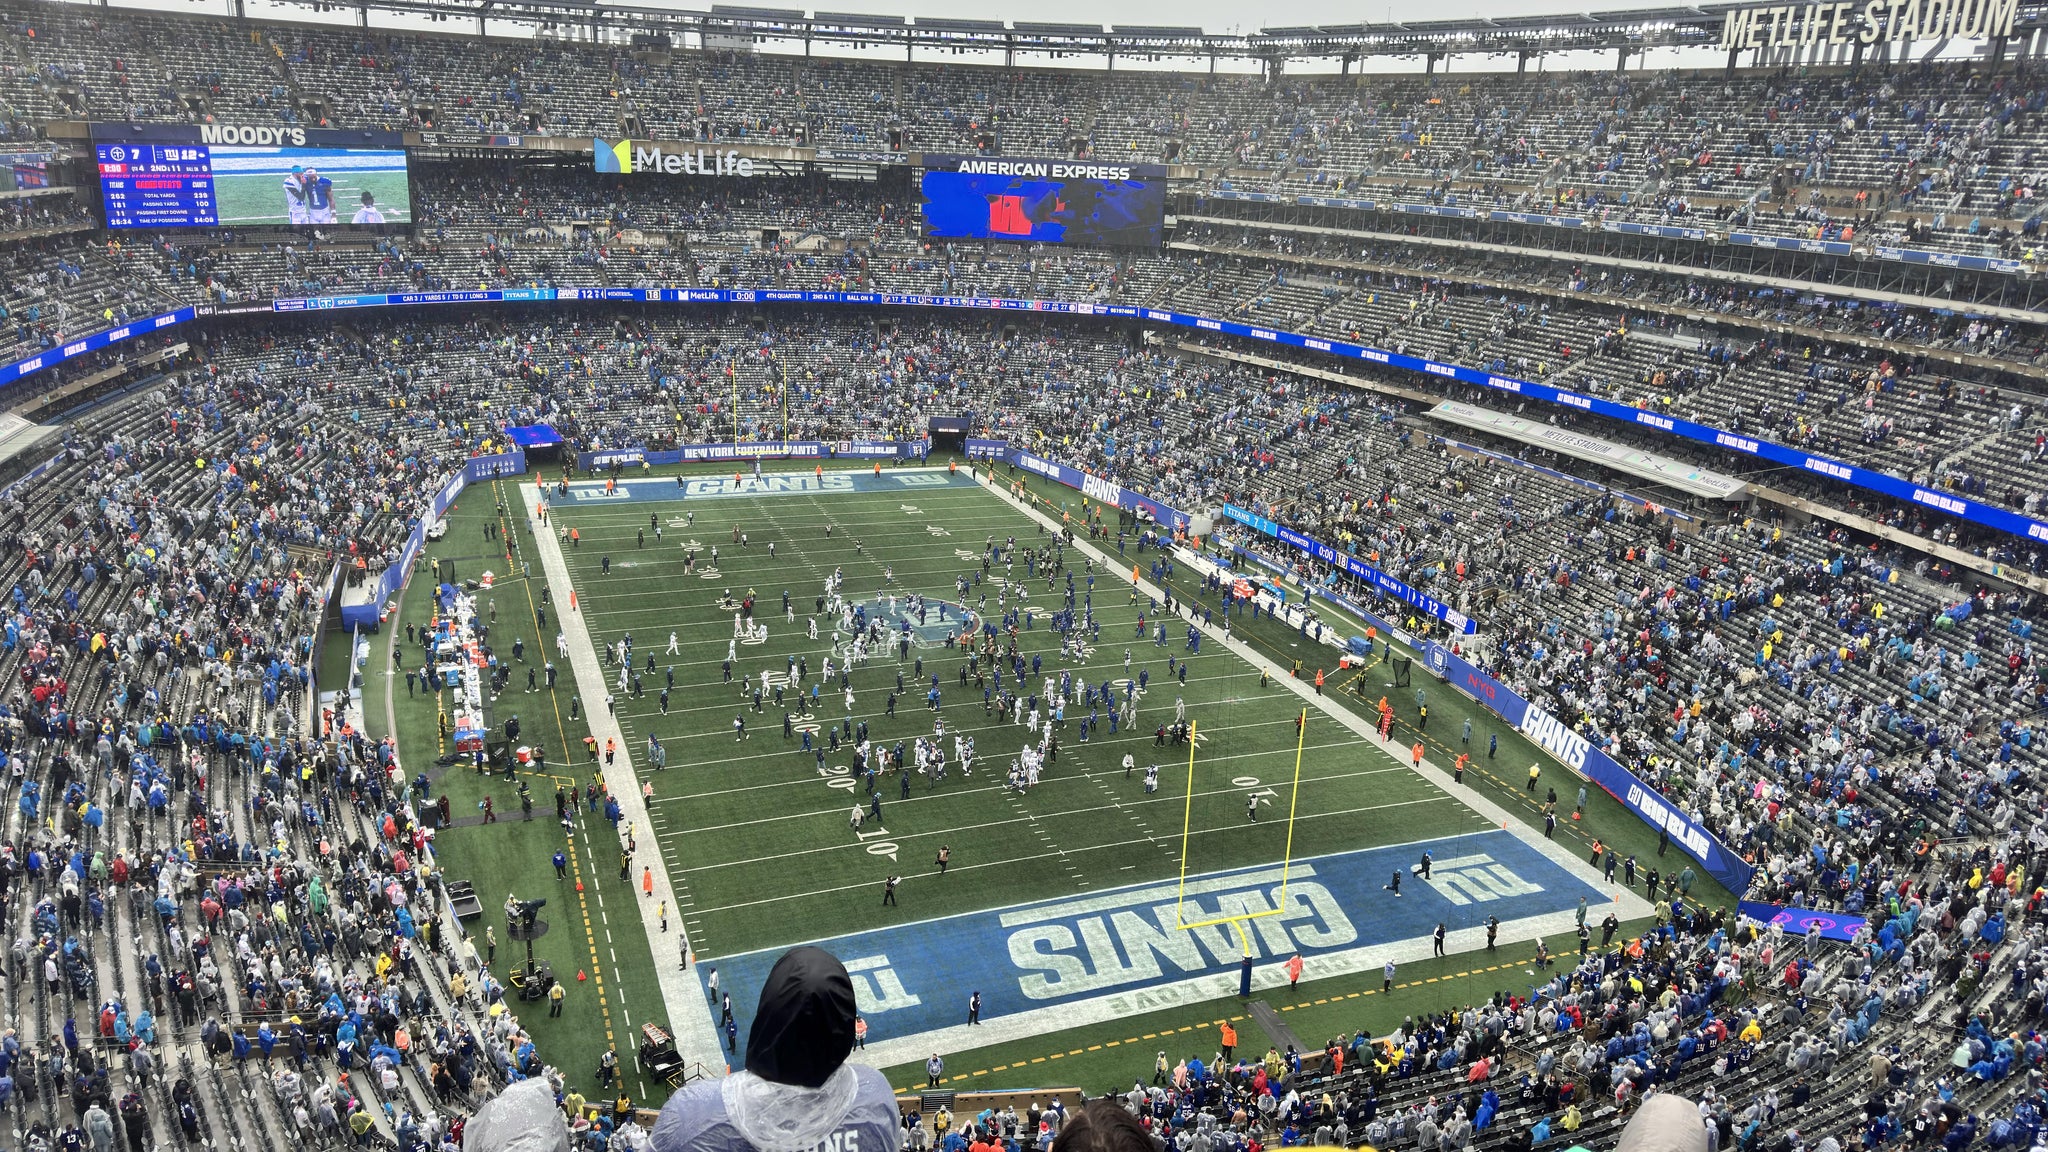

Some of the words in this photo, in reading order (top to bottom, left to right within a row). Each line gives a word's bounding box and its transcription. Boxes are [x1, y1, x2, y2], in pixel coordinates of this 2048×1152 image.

[1720, 4, 1852, 50] METLIFE
[1860, 0, 2018, 43] STADIUM
[202, 125, 306, 146] MOODY'S
[132, 149, 140, 159] 7
[181, 150, 197, 160] 12
[636, 148, 754, 177] MetLife
[858, 160, 1047, 177] AMERICAN
[1052, 164, 1130, 180] EXPRESS
[534, 290, 539, 299] 7
[557, 290, 579, 298] GIANTS
[582, 290, 593, 298] 12
[690, 292, 718, 300] MetLife
[736, 292, 754, 300] 0:00
[1563, 394, 1574, 404] BIG
[1574, 396, 1591, 409] BLUE
[1643, 414, 1656, 425] BIG
[1655, 417, 1674, 430] BLUE
[1543, 430, 1574, 444] METLIFE
[1573, 440, 1612, 455] STADIUM
[1724, 435, 1738, 448] BIG
[1737, 438, 1759, 453] BLUE
[685, 448, 707, 458] NEW
[709, 447, 734, 458] YORK
[1813, 460, 1829, 474] BIG
[1828, 464, 1852, 480] BLUE
[685, 476, 854, 495] GIANTS
[1083, 474, 1121, 505] GIANTS
[1702, 476, 1731, 490] MetLife
[1922, 492, 1940, 507] BIG
[1939, 496, 1966, 515] BLUE
[1228, 507, 1250, 521] TITANS
[1254, 518, 1259, 527] 7
[1280, 531, 1289, 539] 4TH
[1290, 534, 1309, 548] QUARTER
[1319, 546, 1333, 560] 0:00
[1338, 554, 1346, 566] 18
[1350, 563, 1360, 572] 2ND
[1364, 569, 1371, 578] 11
[1379, 576, 1390, 588] BALL
[1390, 581, 1397, 591] ON
[1398, 585, 1402, 593] 9
[1428, 600, 1439, 615] 12
[1446, 607, 1468, 630] GIANTS
[1468, 674, 1494, 699] NYG
[788, 712, 821, 733] 30
[1521, 703, 1591, 770] GIANTS
[818, 766, 857, 788] 20
[1232, 776, 1279, 798] 10
[1627, 784, 1642, 806] GO
[1640, 792, 1669, 829] BIG
[1666, 811, 1710, 861] BLUE
[856, 827, 899, 855] 10
[1006, 881, 1358, 1000] GIANTS
[1915, 1120, 1925, 1131] 10
[66, 1134, 76, 1143] 13
